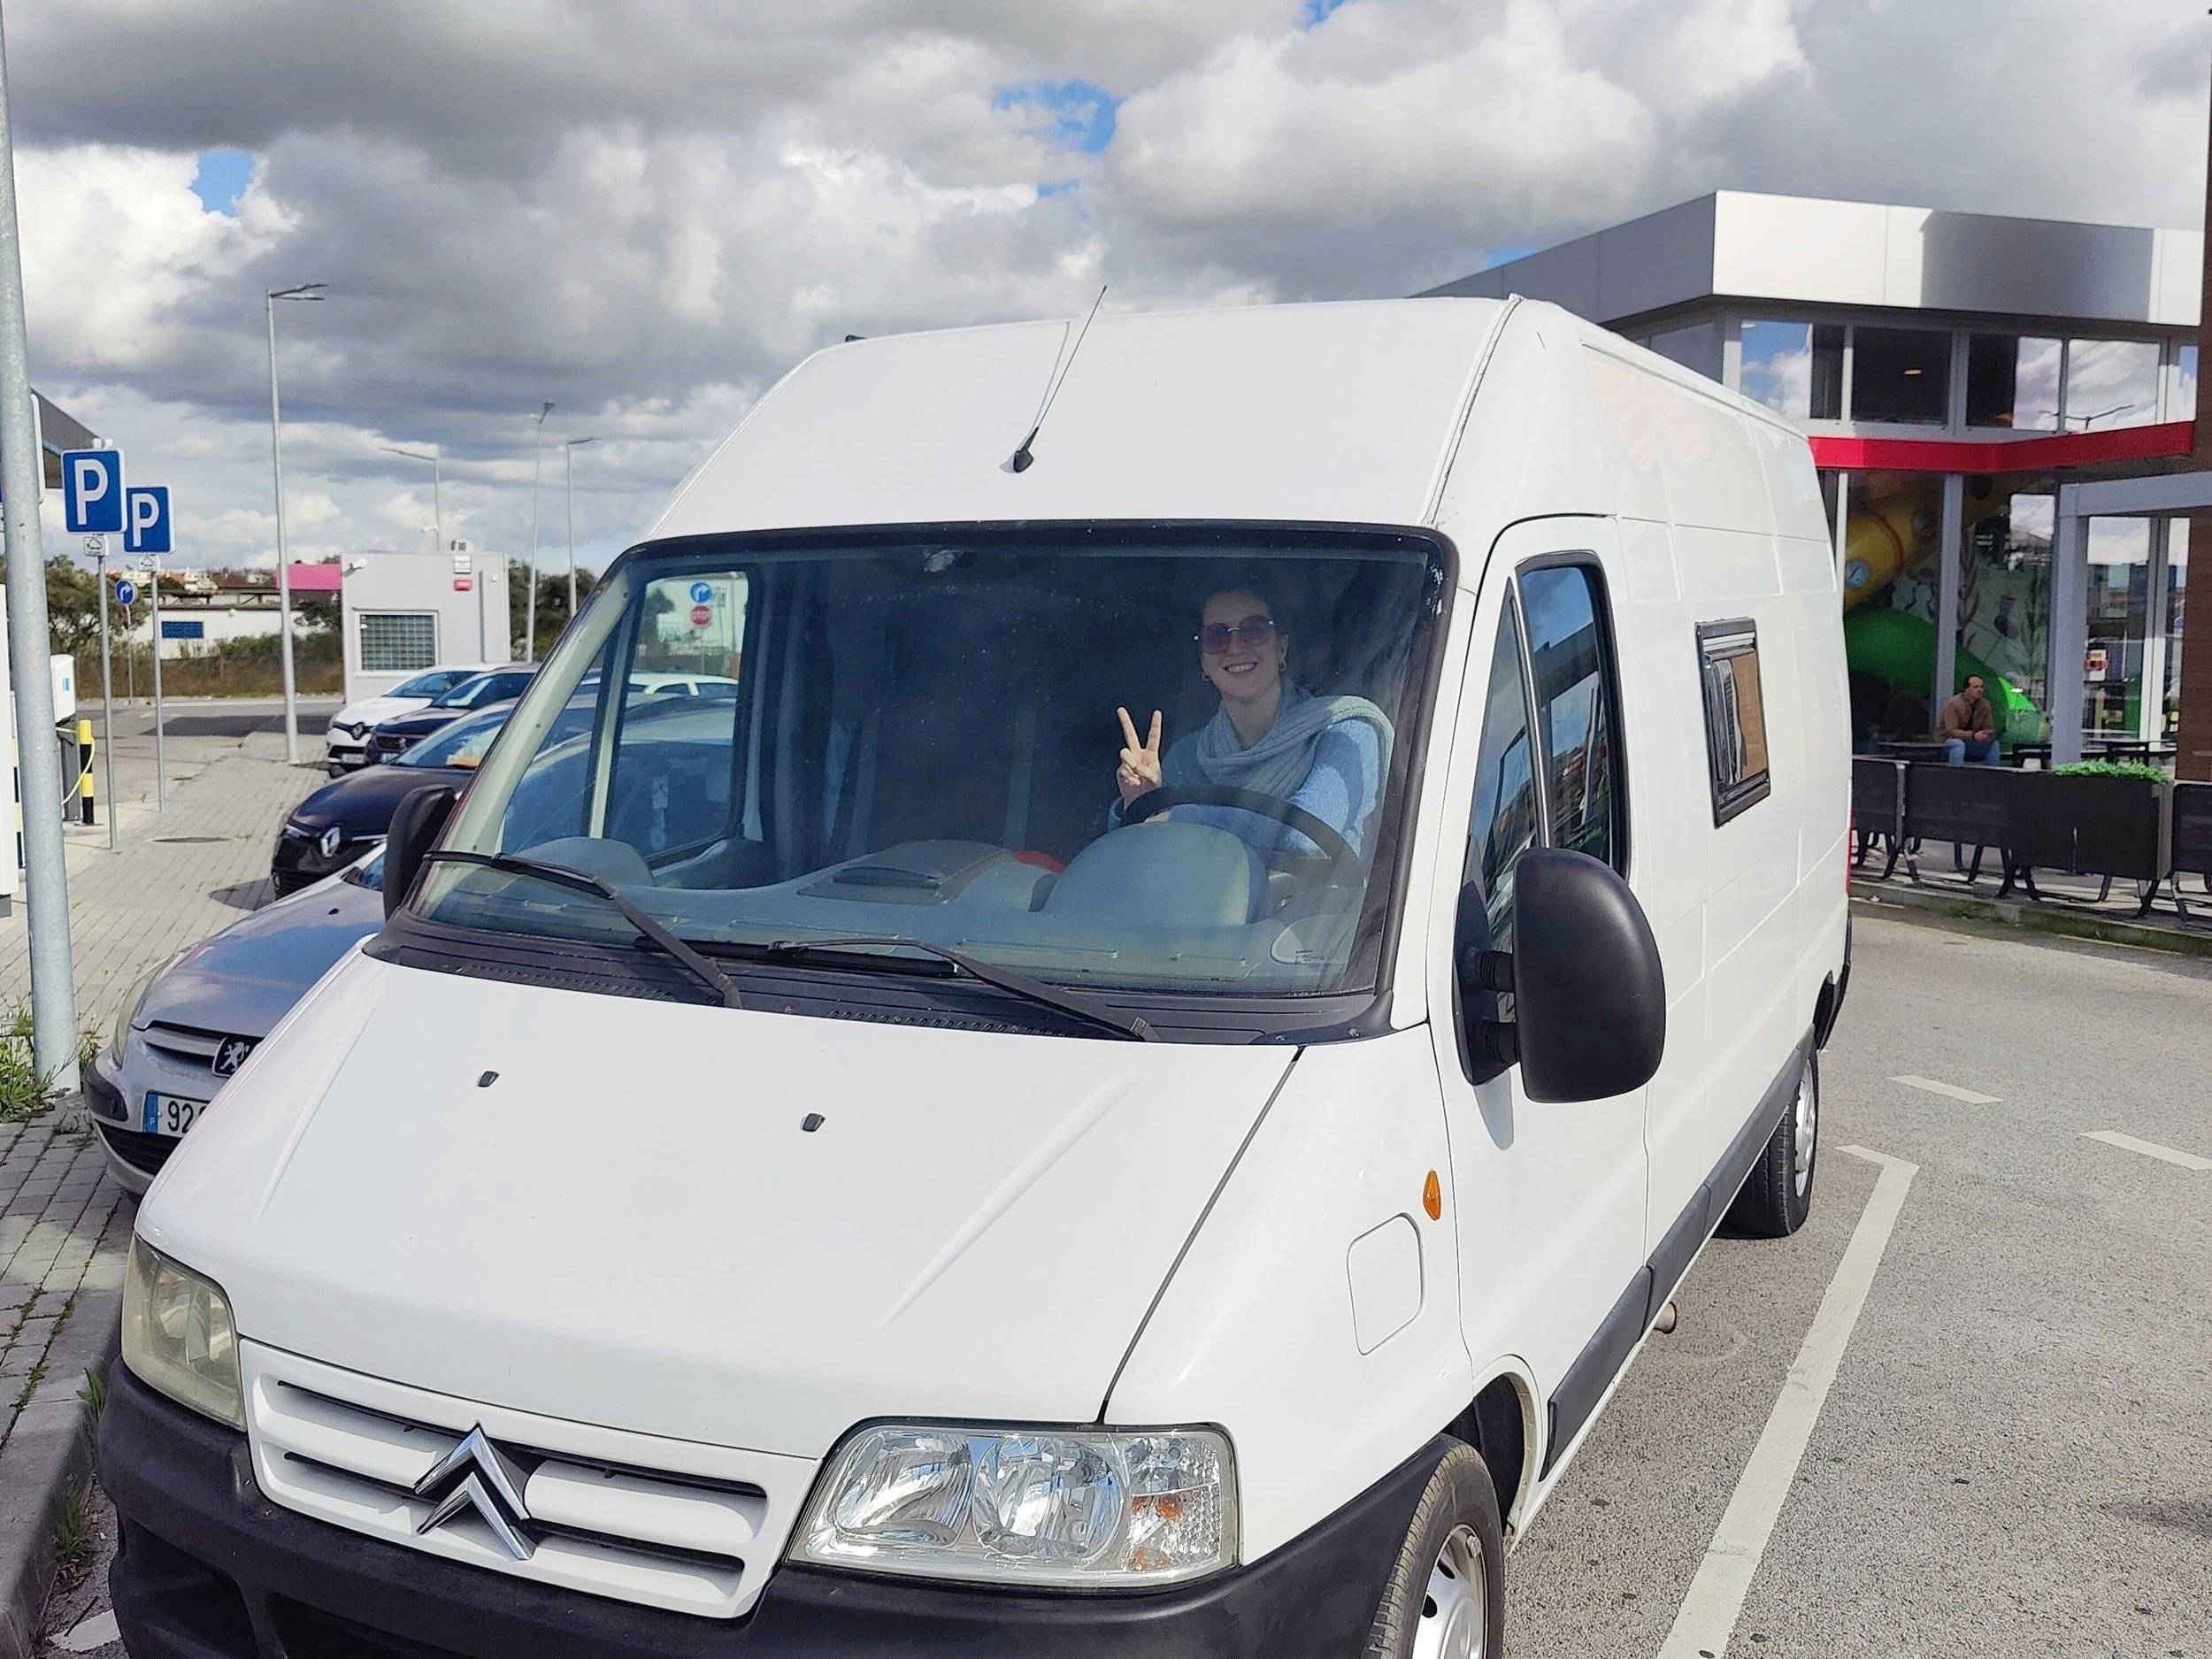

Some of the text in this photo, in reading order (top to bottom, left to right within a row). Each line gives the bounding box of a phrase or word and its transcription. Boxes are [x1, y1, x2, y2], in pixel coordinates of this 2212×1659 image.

[74, 458, 108, 526] P
[132, 493, 159, 547] P
[150, 1117, 156, 1125] P
